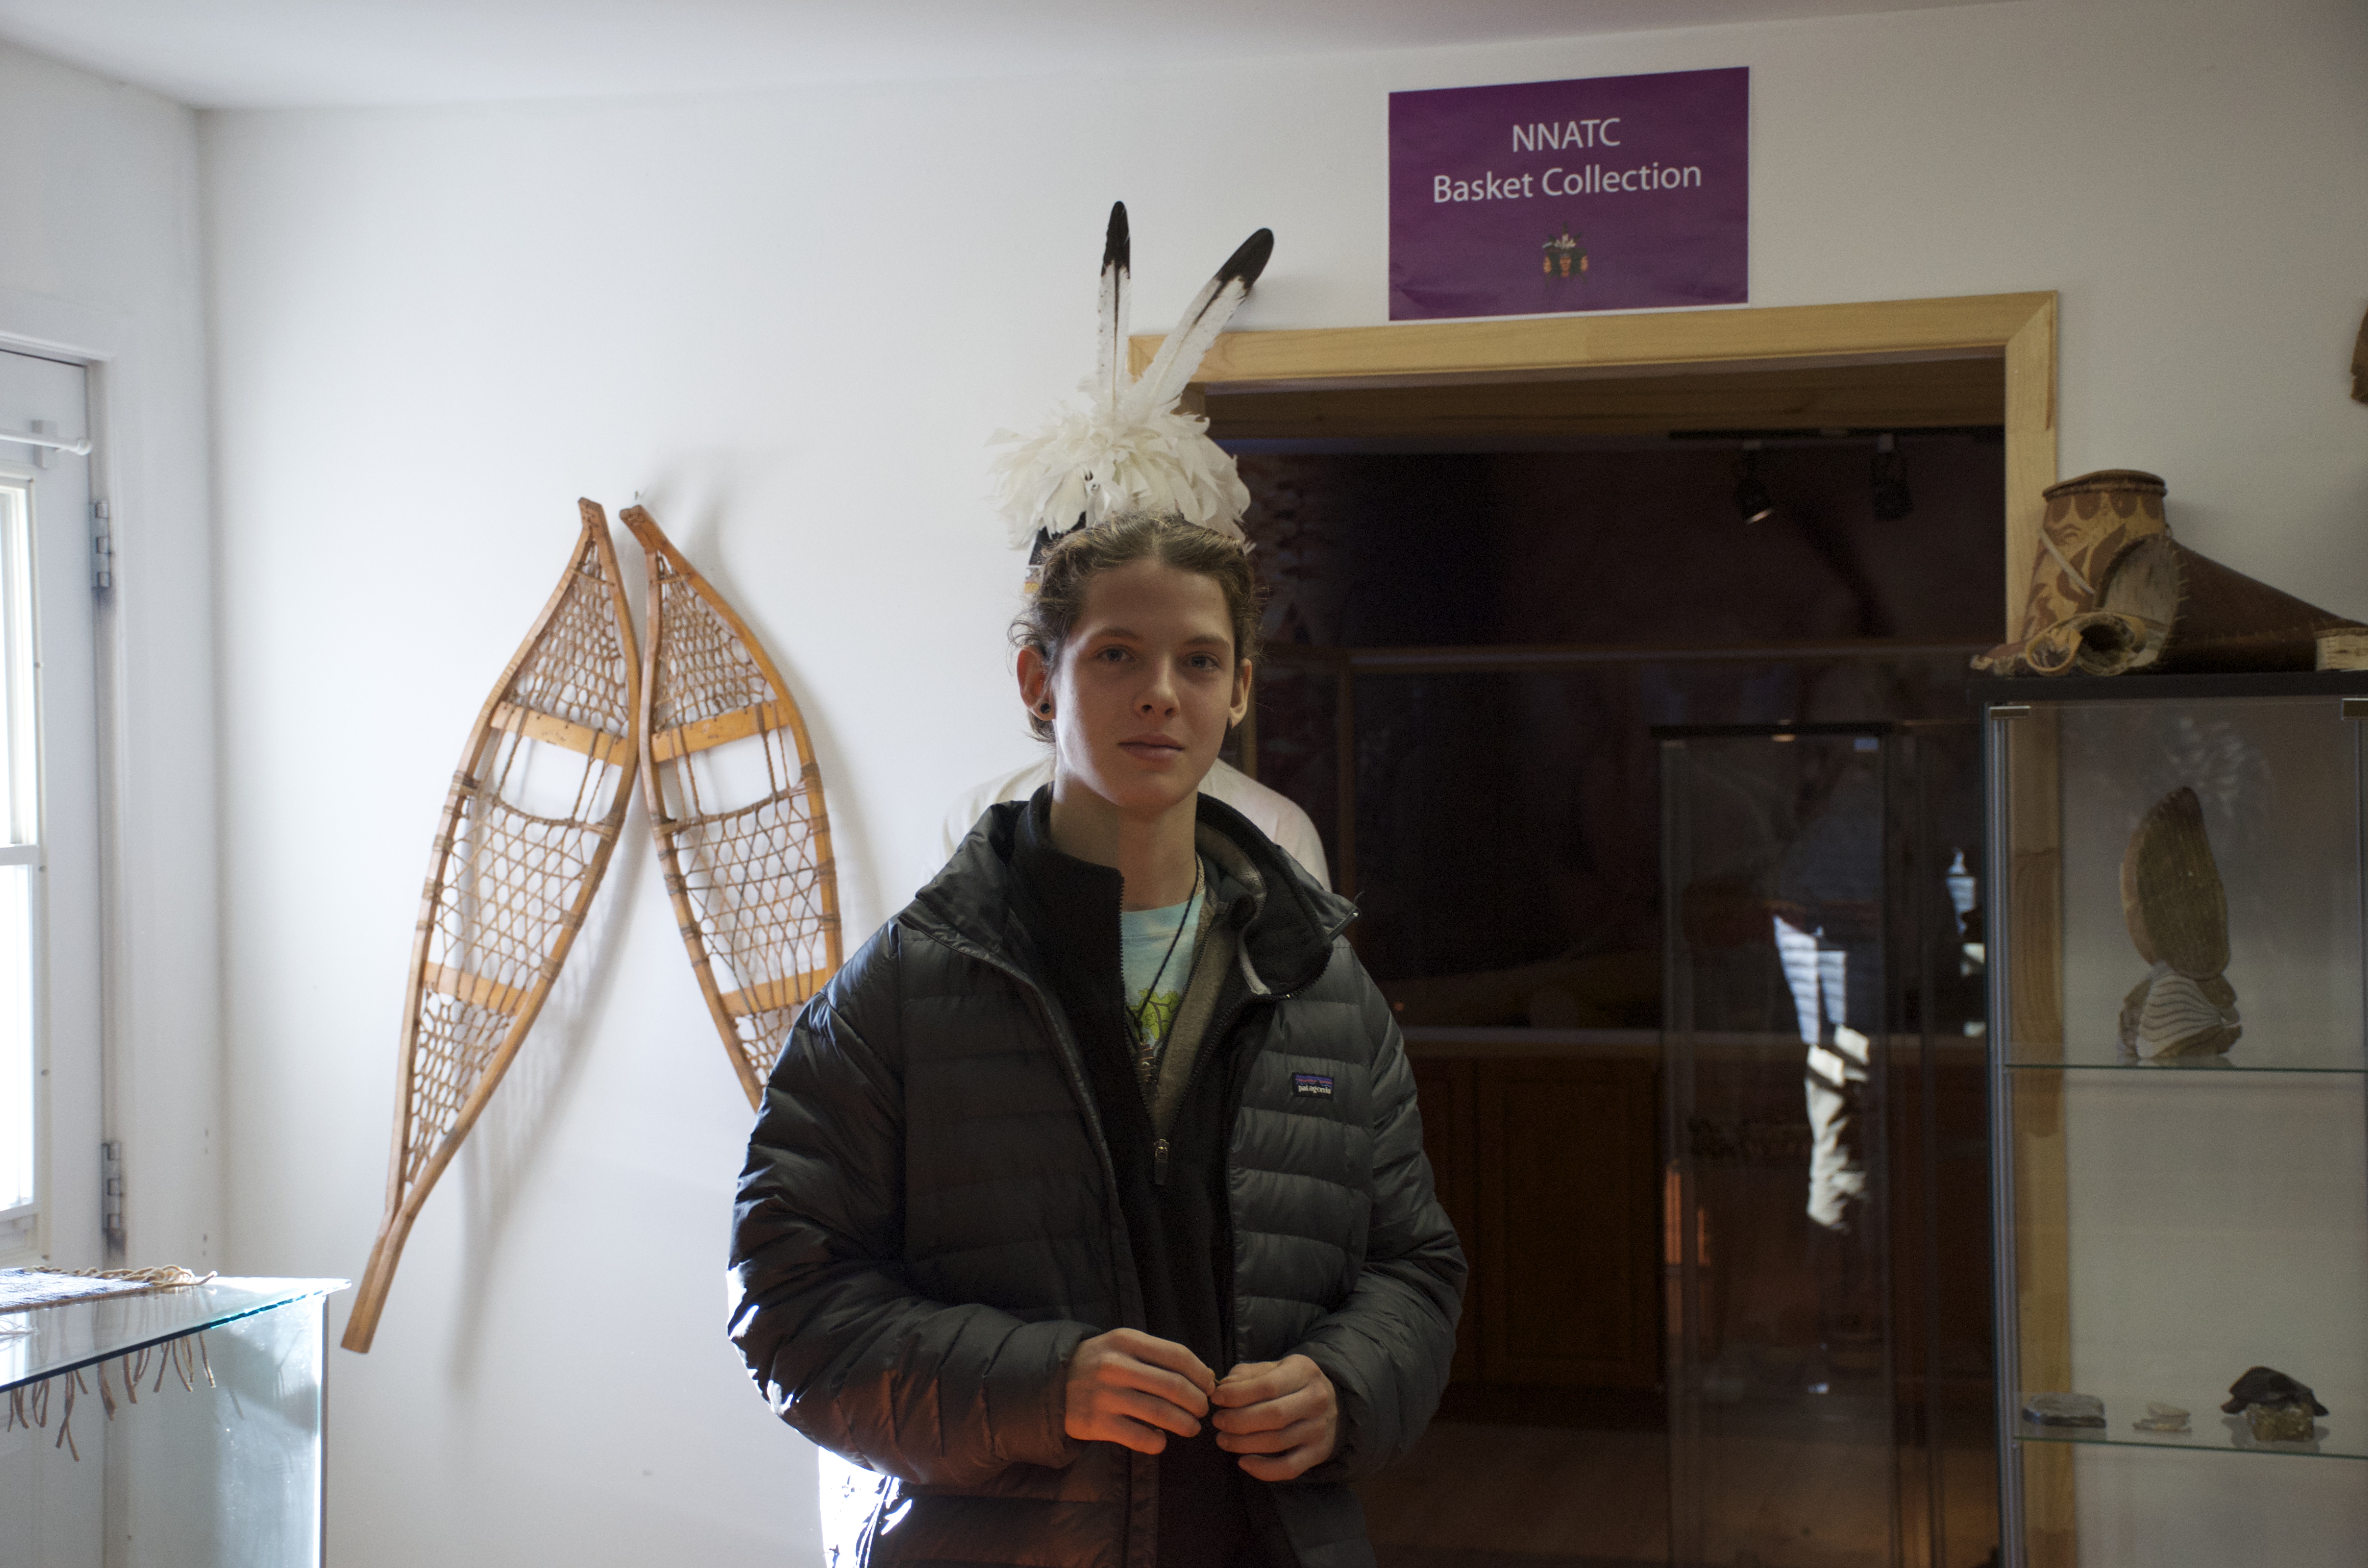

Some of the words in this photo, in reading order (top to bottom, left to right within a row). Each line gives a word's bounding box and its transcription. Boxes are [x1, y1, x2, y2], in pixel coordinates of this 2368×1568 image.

[1513, 118, 1620, 152] NNATC
[1434, 171, 1533, 203] Basket
[1542, 162, 1701, 196] Collection
[1298, 1085, 1331, 1094] patagonia
